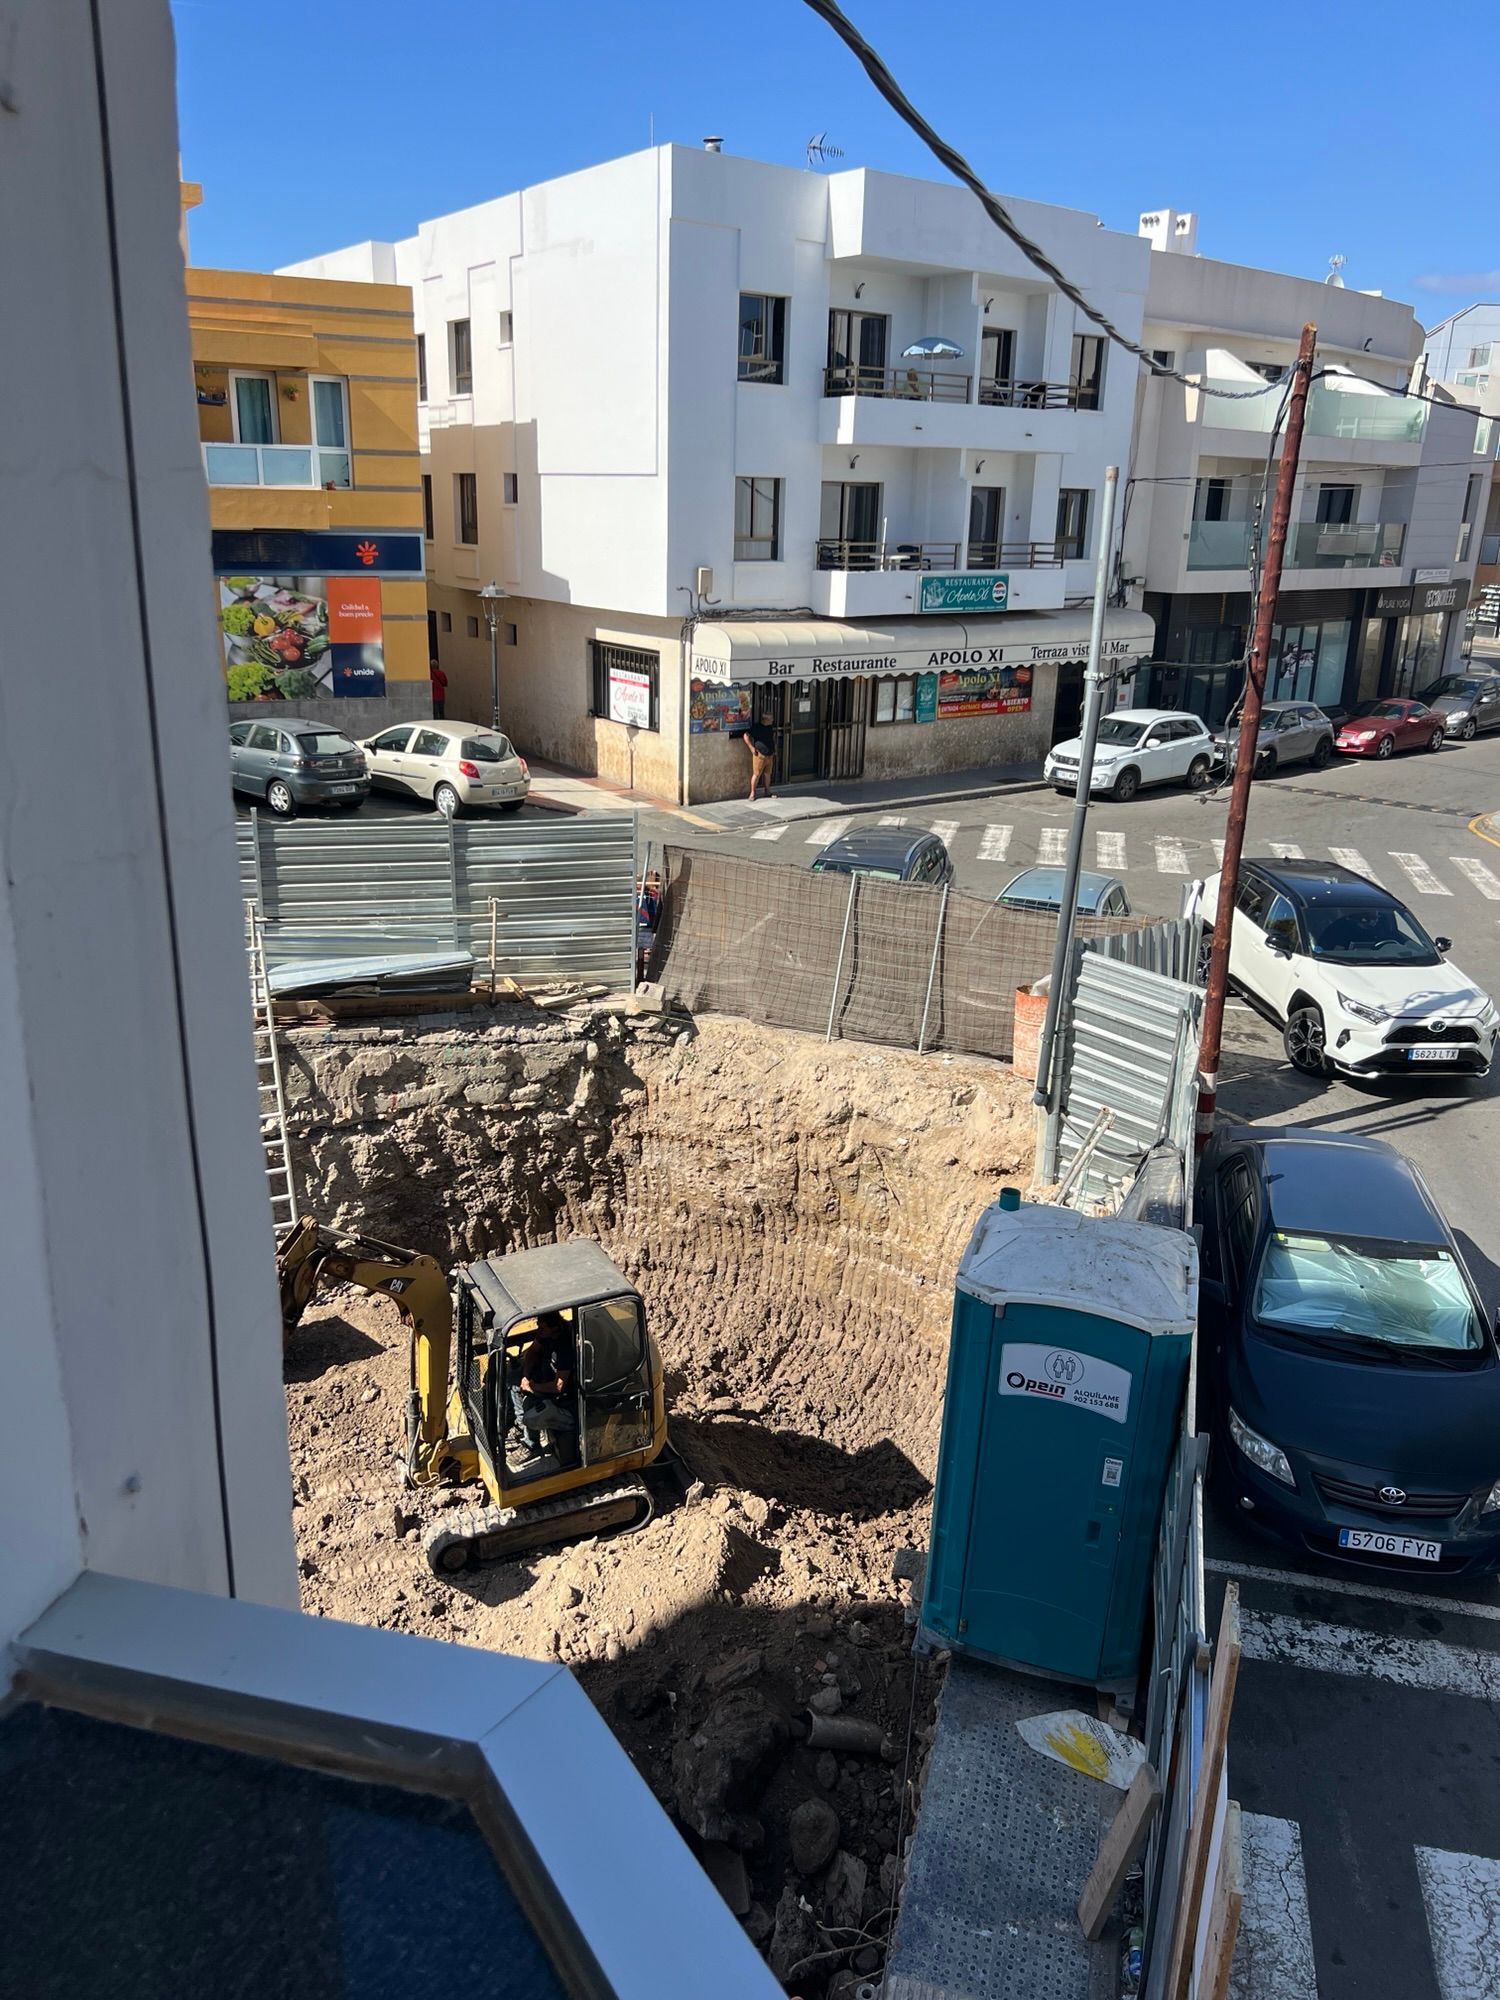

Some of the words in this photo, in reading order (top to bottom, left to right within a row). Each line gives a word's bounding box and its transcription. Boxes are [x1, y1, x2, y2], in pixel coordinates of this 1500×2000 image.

[945, 578, 994, 586] RESTAURANTE
[341, 603, 364, 611] Calidad
[355, 611, 374, 619] precio
[928, 649, 983, 666] APOLO
[987, 648, 1003, 662] XI
[1031, 646, 1068, 659] Terraza
[1072, 643, 1090, 656] vist
[1110, 641, 1130, 654] Mar
[353, 668, 375, 677] unide
[695, 657, 718, 674] APOLO
[720, 661, 727, 676] XI
[768, 661, 795, 676] Bar
[812, 656, 897, 673] Restaurante
[959, 673, 987, 687] Apolo
[989, 672, 1000, 682] XI
[697, 689, 727, 703] Apolo
[1002, 697, 1029, 706] ABIERTO
[1414, 1050, 1438, 1059] 5623
[1438, 1050, 1456, 1059] LTX
[1006, 1372, 1066, 1396] Opein
[1073, 1395, 1088, 1404] 902
[1089, 1398, 1103, 1407] 153
[1104, 1401, 1119, 1409] 688
[1352, 1532, 1396, 1551] 5706
[1401, 1538, 1437, 1558] FYR
